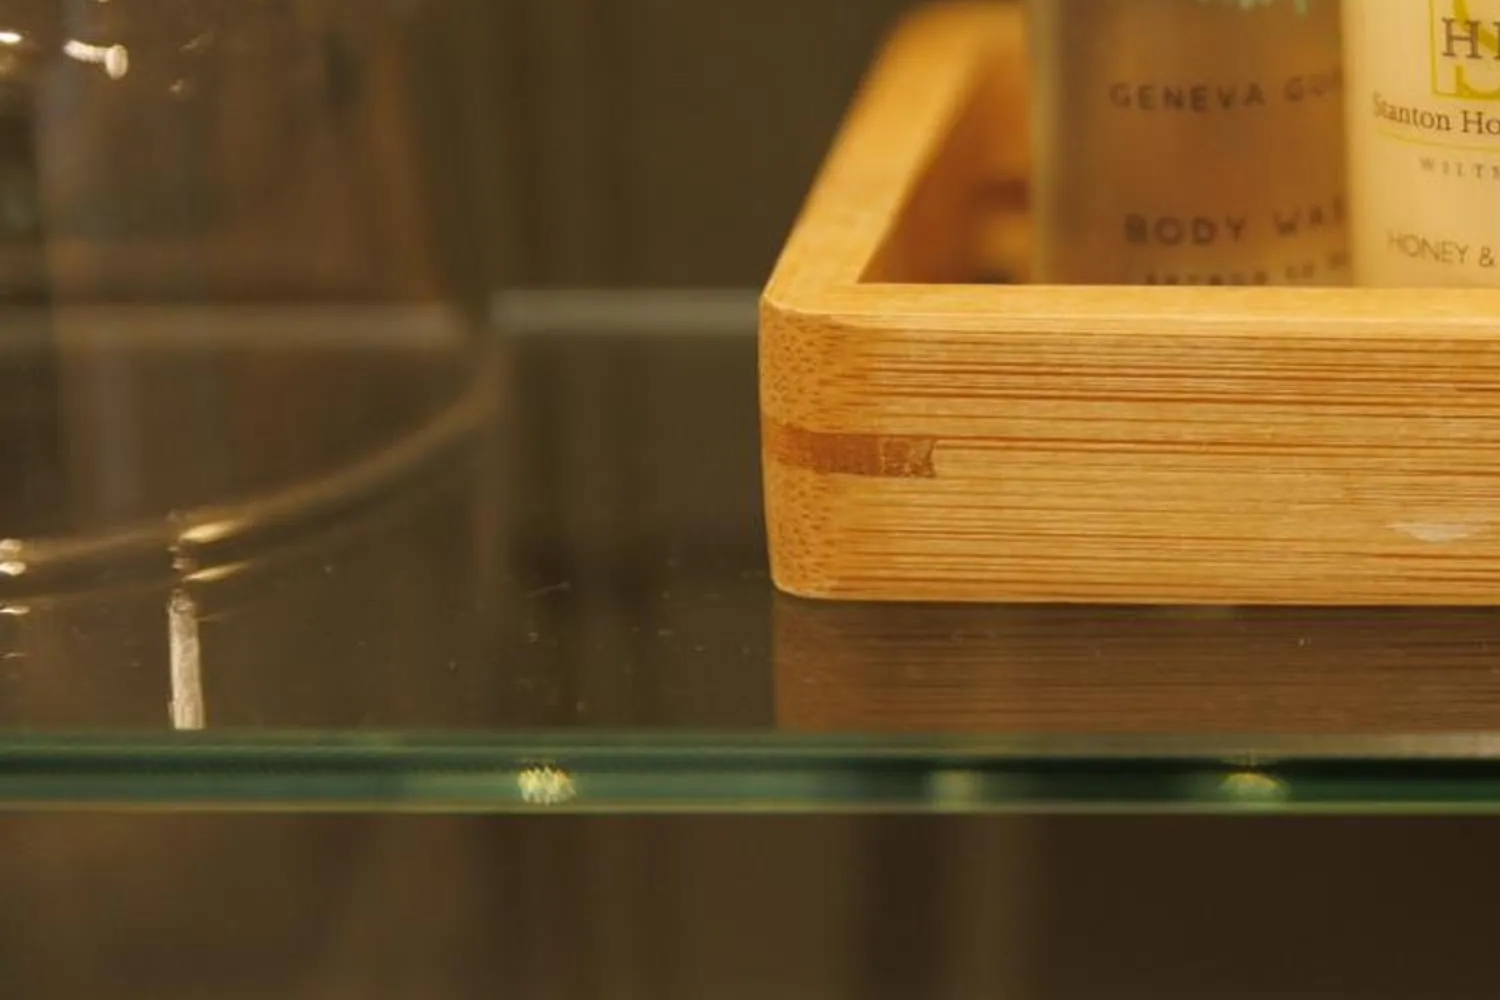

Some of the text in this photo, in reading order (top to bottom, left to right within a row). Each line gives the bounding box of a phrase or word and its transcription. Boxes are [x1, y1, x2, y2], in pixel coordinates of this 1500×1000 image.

[1109, 81, 1266, 112] GENEVA
[1372, 89, 1452, 133] Stanton
[1124, 212, 1247, 246] BODY
[1385, 228, 1470, 266] HONEY
[1478, 244, 1497, 268] &
